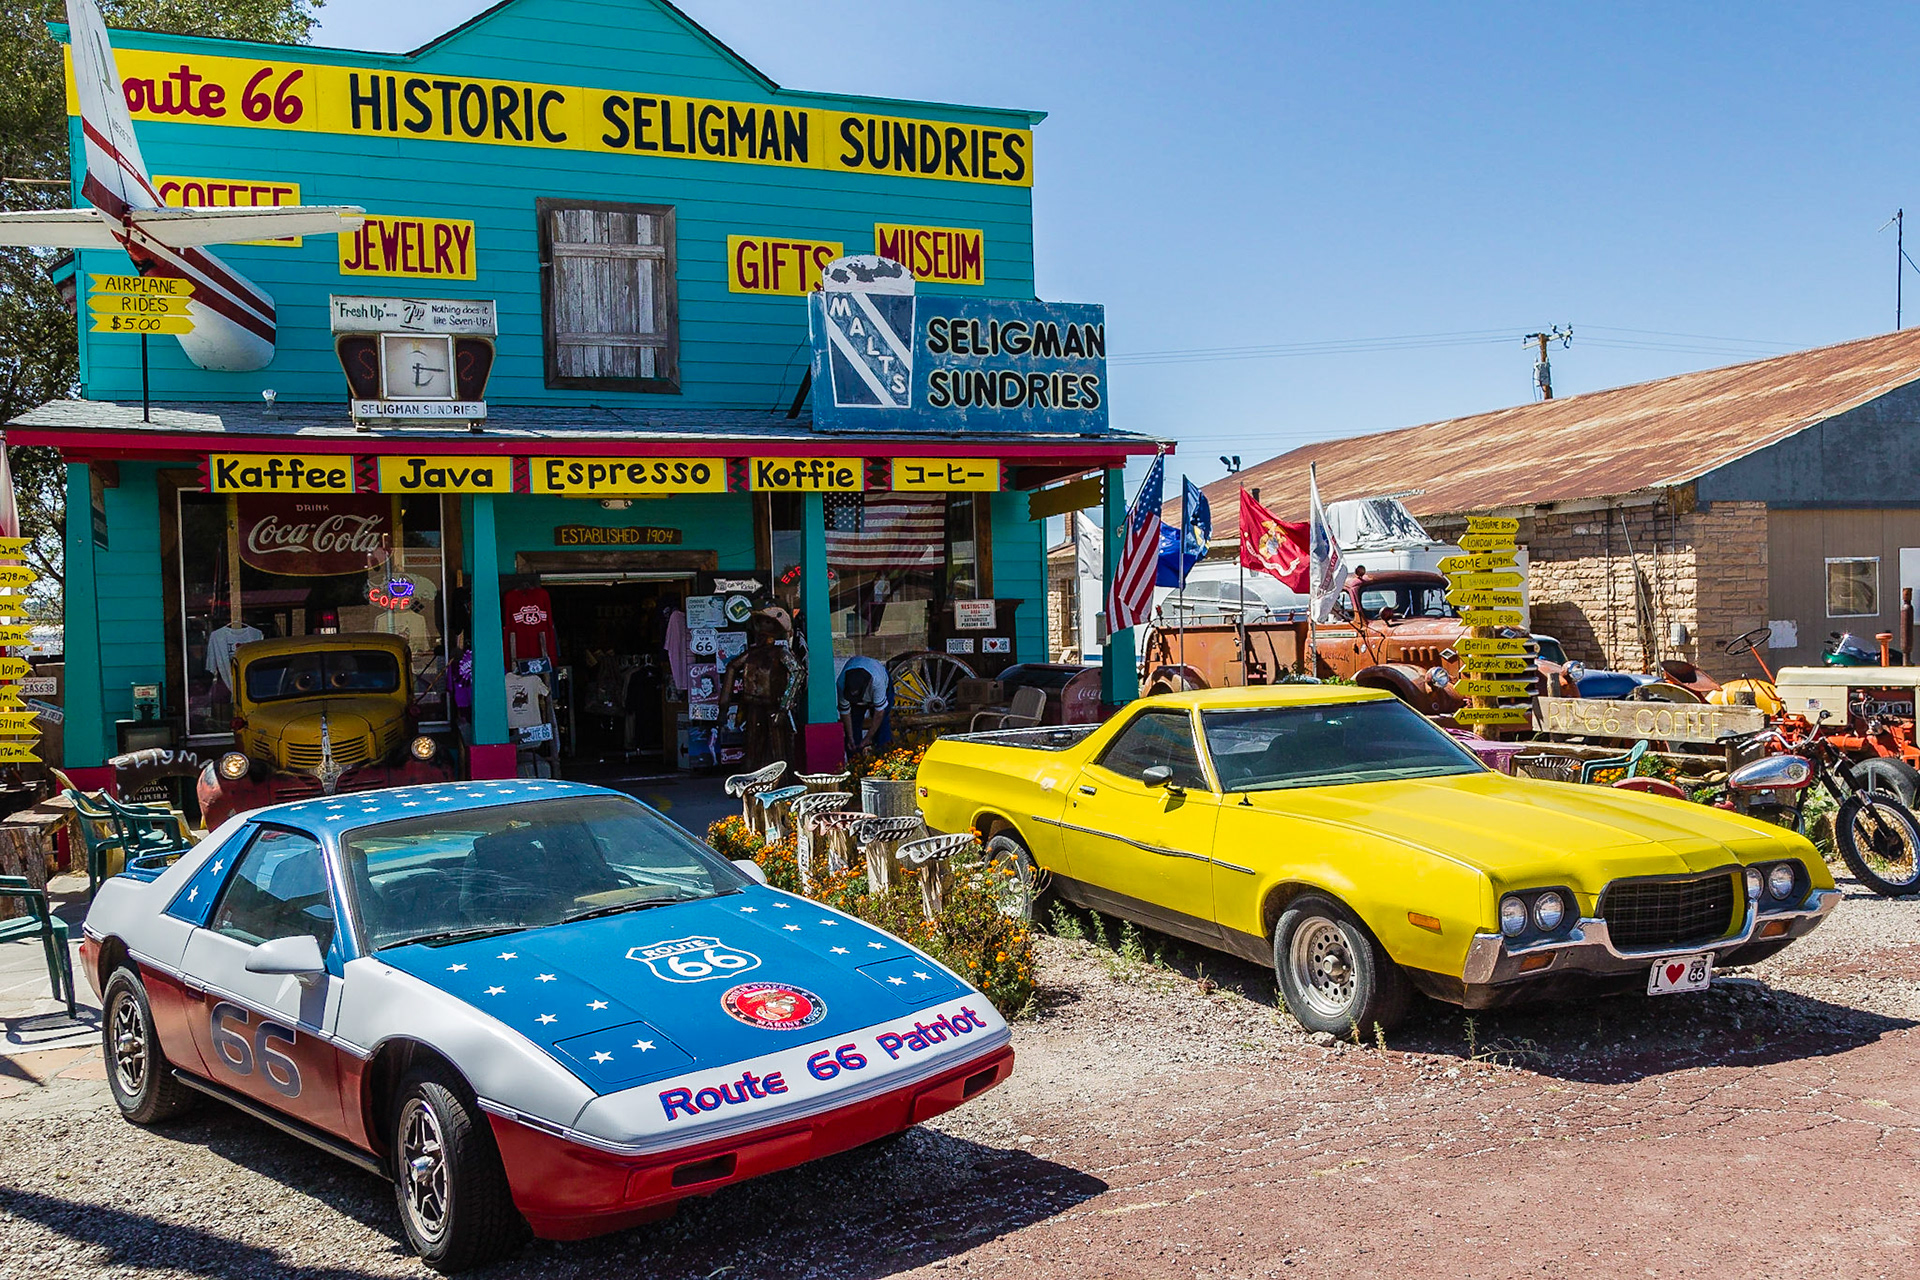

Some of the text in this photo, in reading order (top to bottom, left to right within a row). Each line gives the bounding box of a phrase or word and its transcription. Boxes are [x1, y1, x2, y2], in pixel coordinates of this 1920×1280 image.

[122, 65, 303, 124] oute 66
[349, 73, 1026, 181] HISTORIC SELIGMAN SUNDRIES
[344, 221, 471, 275] JEWELRY
[879, 228, 980, 281] MUSEUM
[736, 240, 834, 292] GIFTS
[105, 277, 178, 294] AIRPLANE
[122, 297, 168, 312] RIDES
[431, 305, 488, 315] Nothing does it
[111, 315, 160, 331] $5.00
[433, 315, 492, 328] like Seven-Up!
[830, 297, 905, 393] MALTS
[928, 317, 1105, 358] SELIGMAN
[929, 370, 1101, 410] SUNDRIES
[361, 404, 479, 415] SELIGMAN SUNDRIES
[216, 458, 346, 489] Kaffee
[400, 458, 493, 488] Java
[545, 460, 711, 490] Espresso
[757, 460, 855, 489] Koffie
[905, 463, 985, 485] コーヒー
[296, 504, 329, 512] DRINK
[248, 514, 384, 554] Coca-Cola
[561, 528, 674, 544] ESTABLISHED 1904
[1467, 539, 1492, 548] LONDON
[1450, 558, 1481, 570] ROME
[1460, 593, 1487, 603] LIMA
[1465, 613, 1492, 625] Beijing
[695, 642, 713, 652] 66
[1465, 641, 1490, 651] Berlin
[1469, 659, 1500, 672] Bangkok
[1468, 682, 1491, 693] Paris
[1460, 711, 1500, 720] Amsterdam
[1584, 705, 1620, 734] 66
[1635, 709, 1723, 740] COFFEE
[641, 940, 709, 958] ROUTE
[668, 949, 748, 977] 66
[1652, 965, 1704, 988] I 66
[211, 1001, 302, 1099] 66
[658, 1006, 987, 1121] Route 66 Patriot
